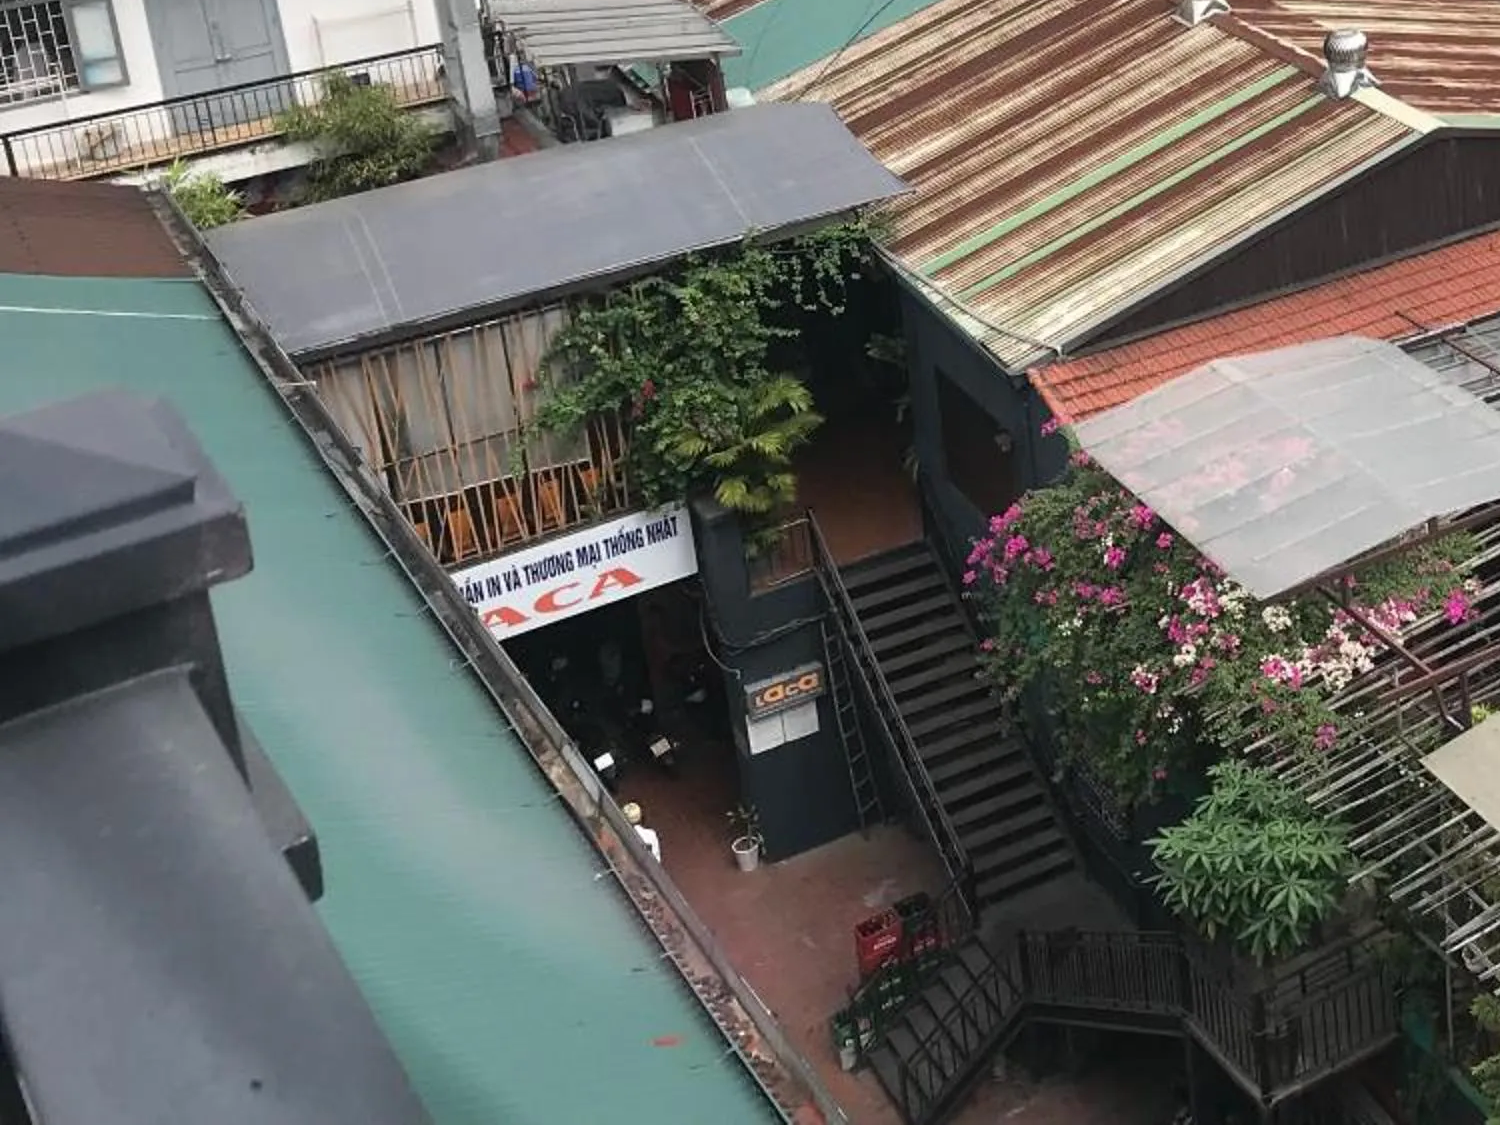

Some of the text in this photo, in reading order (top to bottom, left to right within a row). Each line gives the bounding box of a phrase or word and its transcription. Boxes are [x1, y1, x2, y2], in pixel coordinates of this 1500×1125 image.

[485, 574, 502, 599] IN
[502, 564, 522, 592] VÀ
[522, 551, 576, 586] THƯƠNG
[575, 541, 602, 569] MẠI
[601, 525, 645, 560] THỐNG
[645, 514, 679, 546] NHẤT
